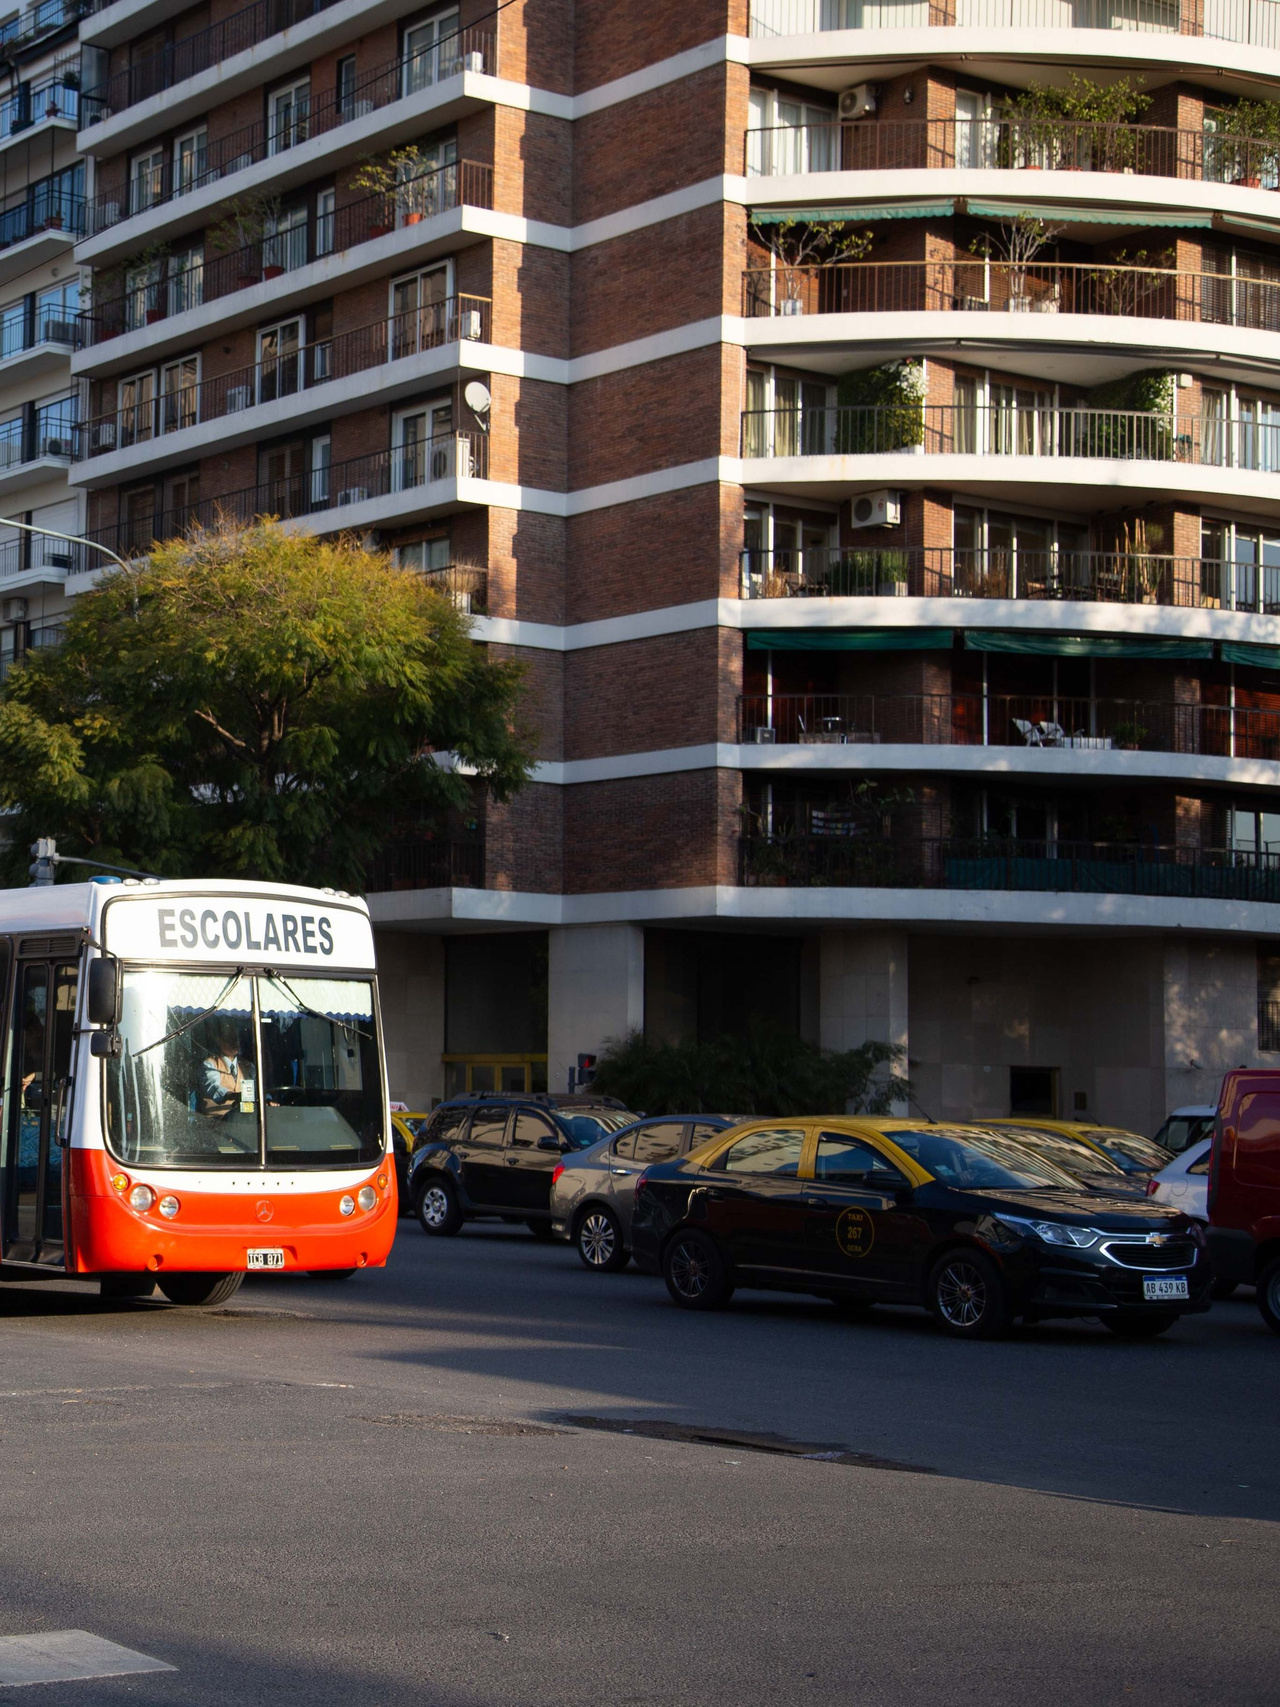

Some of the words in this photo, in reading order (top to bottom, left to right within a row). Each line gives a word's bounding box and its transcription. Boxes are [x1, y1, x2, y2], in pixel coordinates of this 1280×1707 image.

[157, 908, 334, 956] ESCOLARES
[847, 1213, 863, 1221] TAXI
[847, 1226, 862, 1239] 267
[267, 1254, 282, 1265] 871
[1146, 1282, 1156, 1294] AB
[1158, 1282, 1173, 1294] 439
[1175, 1282, 1186, 1294] KB
